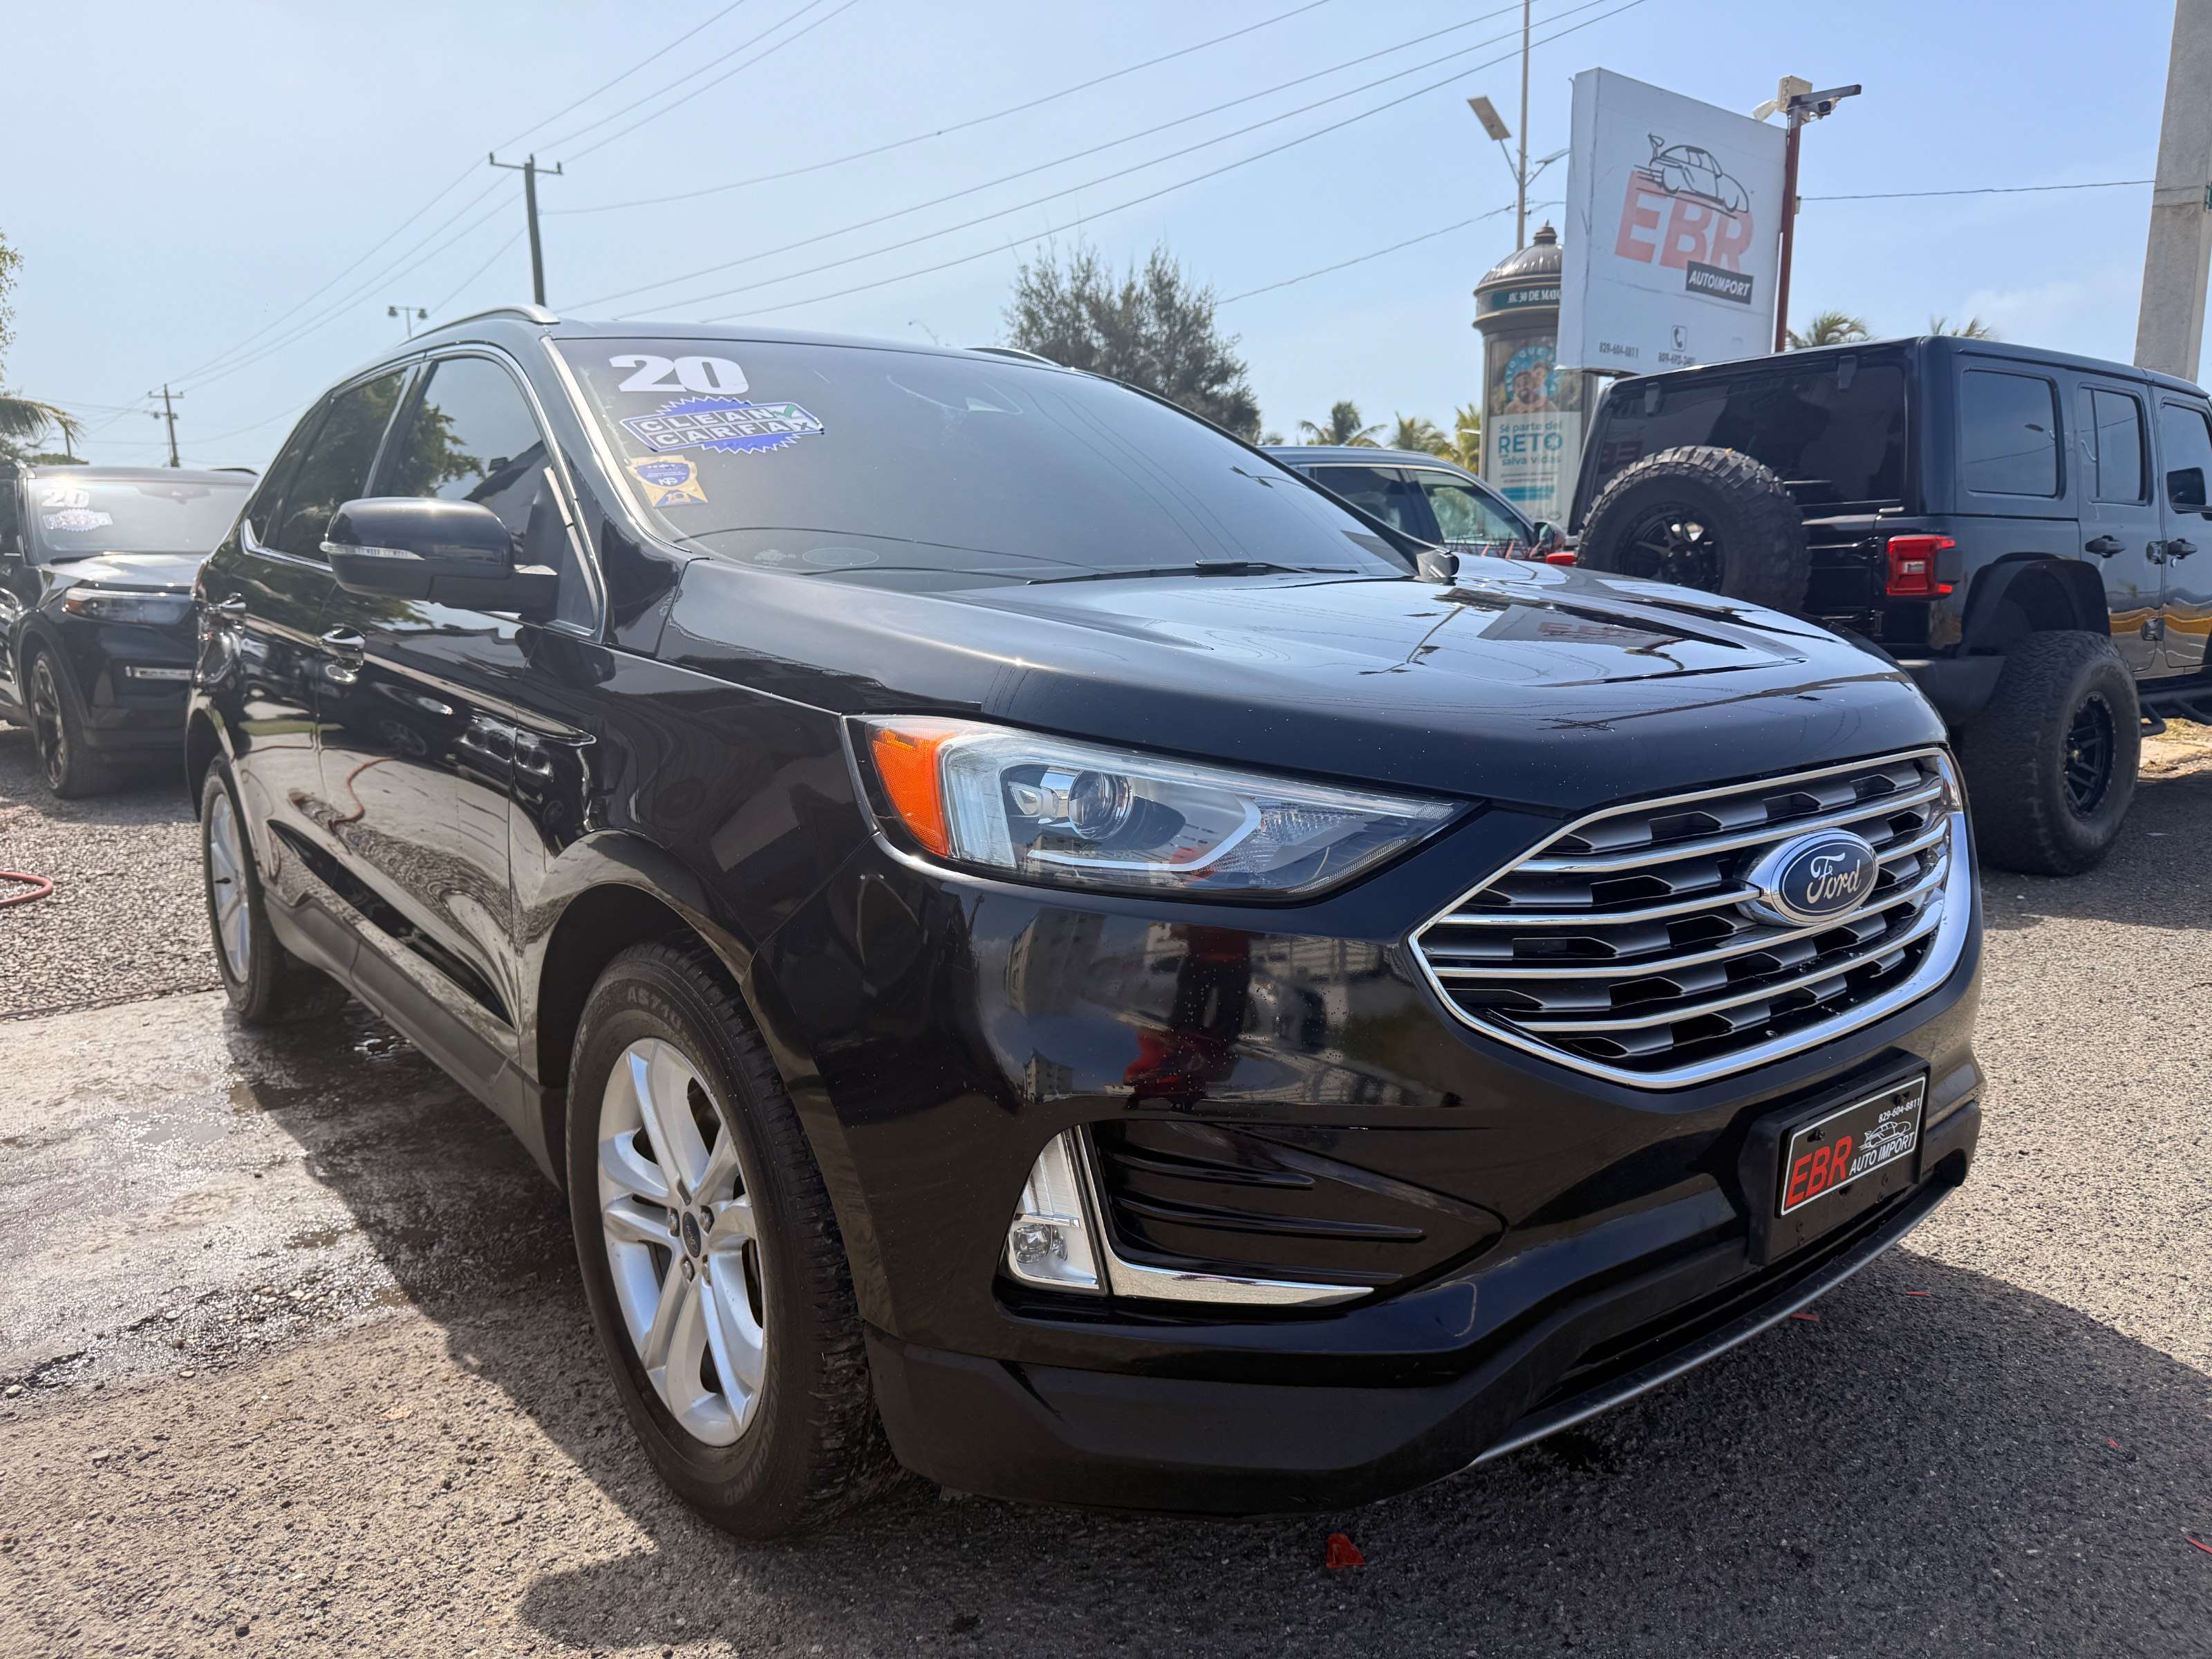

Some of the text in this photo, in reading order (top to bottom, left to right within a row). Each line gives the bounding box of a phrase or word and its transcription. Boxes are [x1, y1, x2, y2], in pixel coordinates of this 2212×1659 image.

[1615, 170, 1754, 274] EBR
[1528, 290, 1540, 301] DE
[1689, 270, 1751, 297] AUTOIMPORT
[609, 355, 749, 395] 20
[639, 407, 777, 432] CLEAN
[1499, 421, 1562, 433] Sé parte del
[657, 420, 812, 445] CARFAX
[1499, 432, 1563, 454] RETO
[1501, 455, 1562, 466] salva vidas
[1806, 852, 1862, 904] Ford
[1878, 1097, 1921, 1123] 829-604-8811
[1785, 1131, 1915, 1208] EBR AUTO IMPORT
